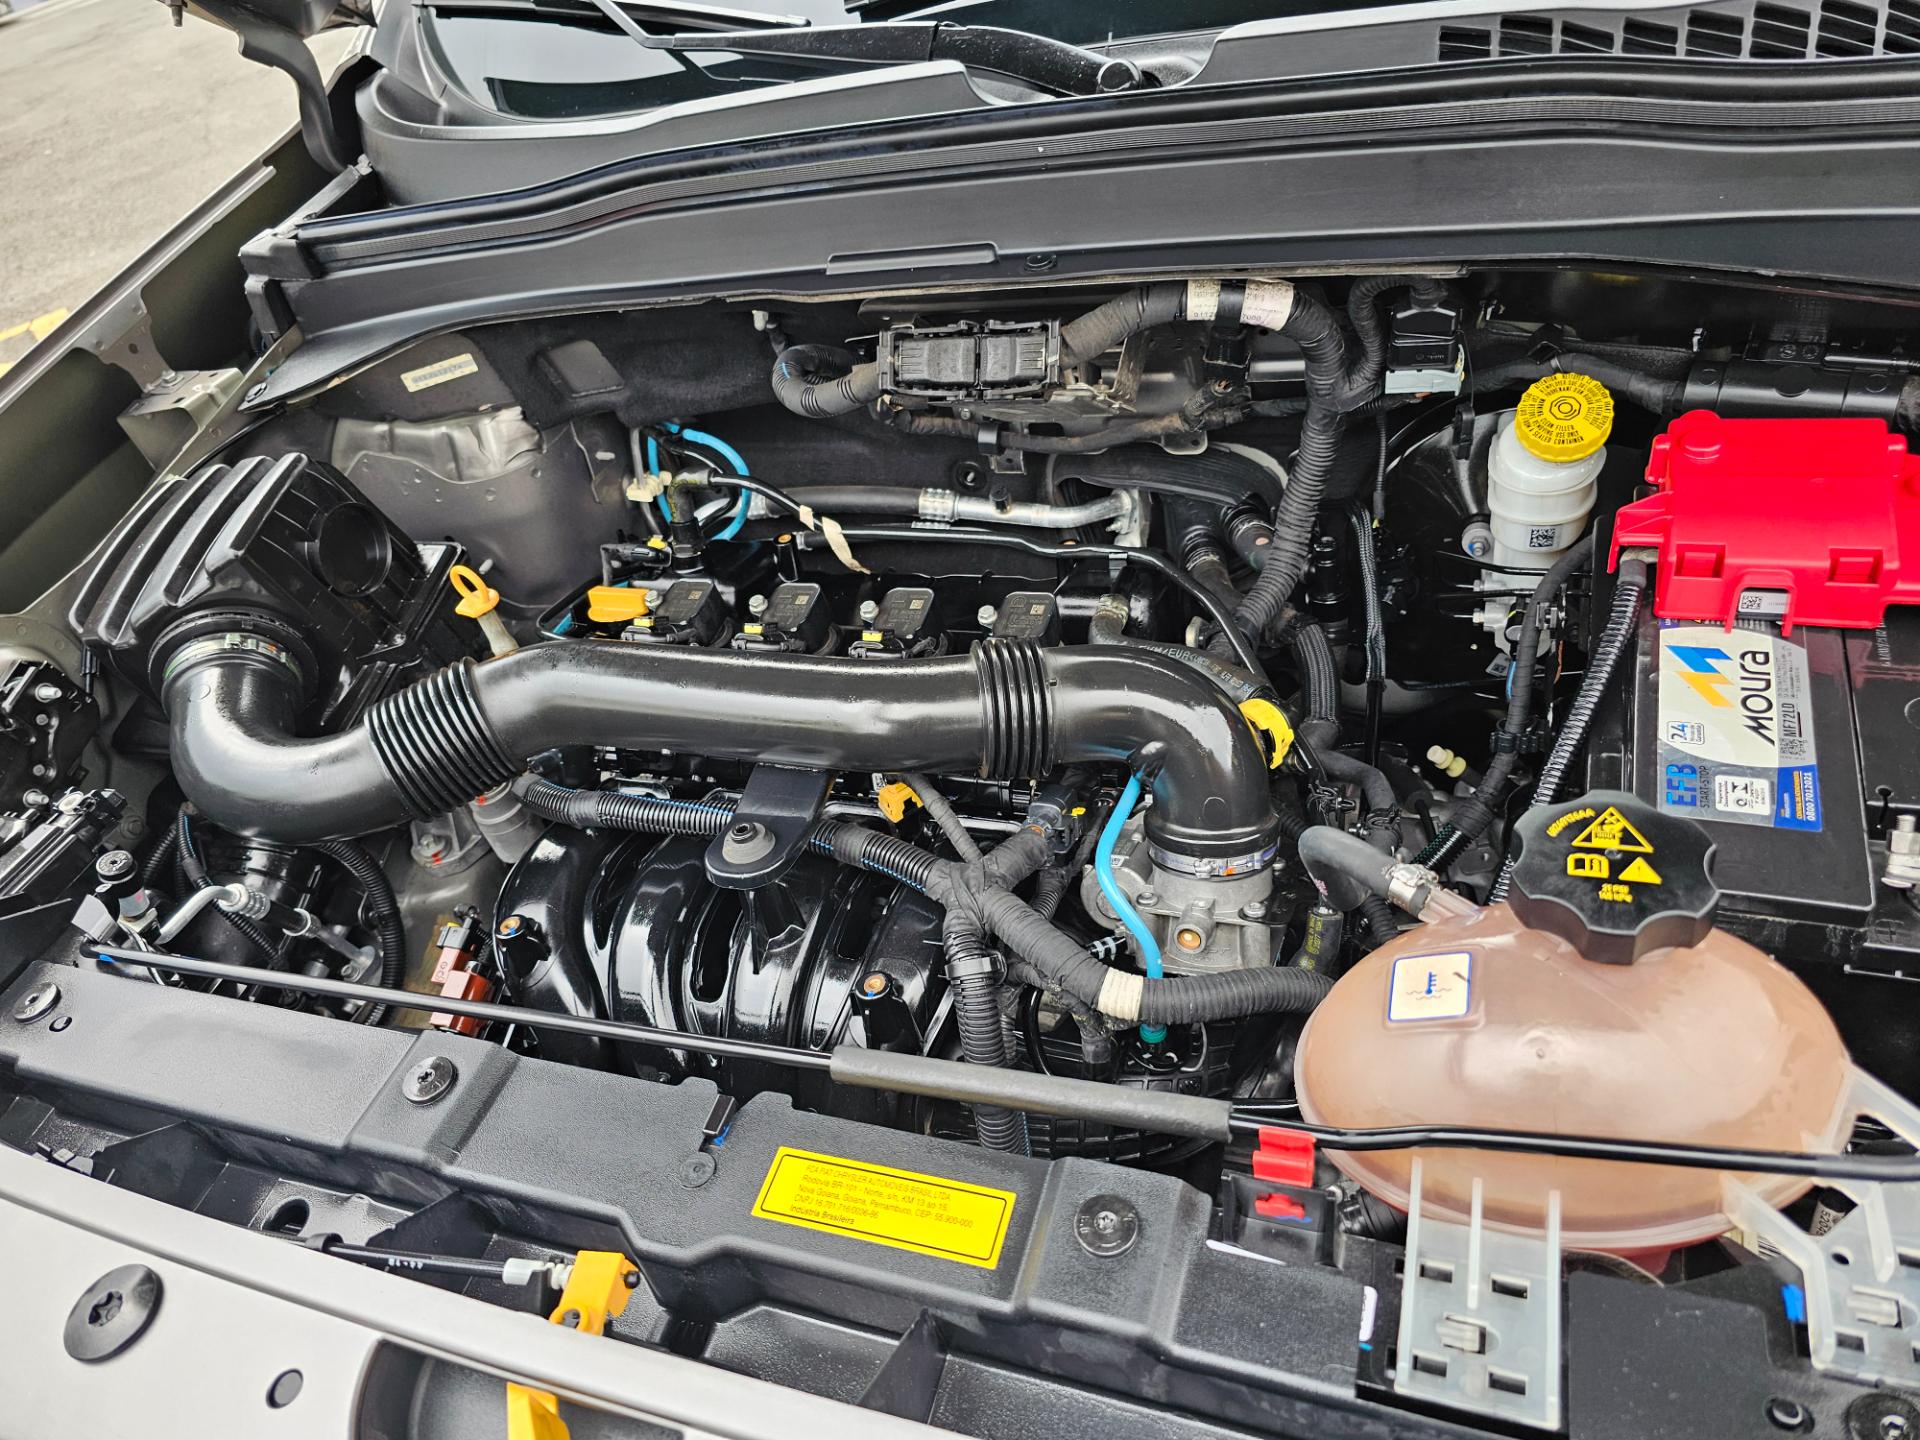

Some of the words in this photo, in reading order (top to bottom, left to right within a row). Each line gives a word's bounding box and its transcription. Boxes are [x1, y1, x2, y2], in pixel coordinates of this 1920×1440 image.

[1670, 723, 1688, 741] 24
[1665, 763, 1697, 807] EFB
[1698, 765, 1710, 809] START-STOP
